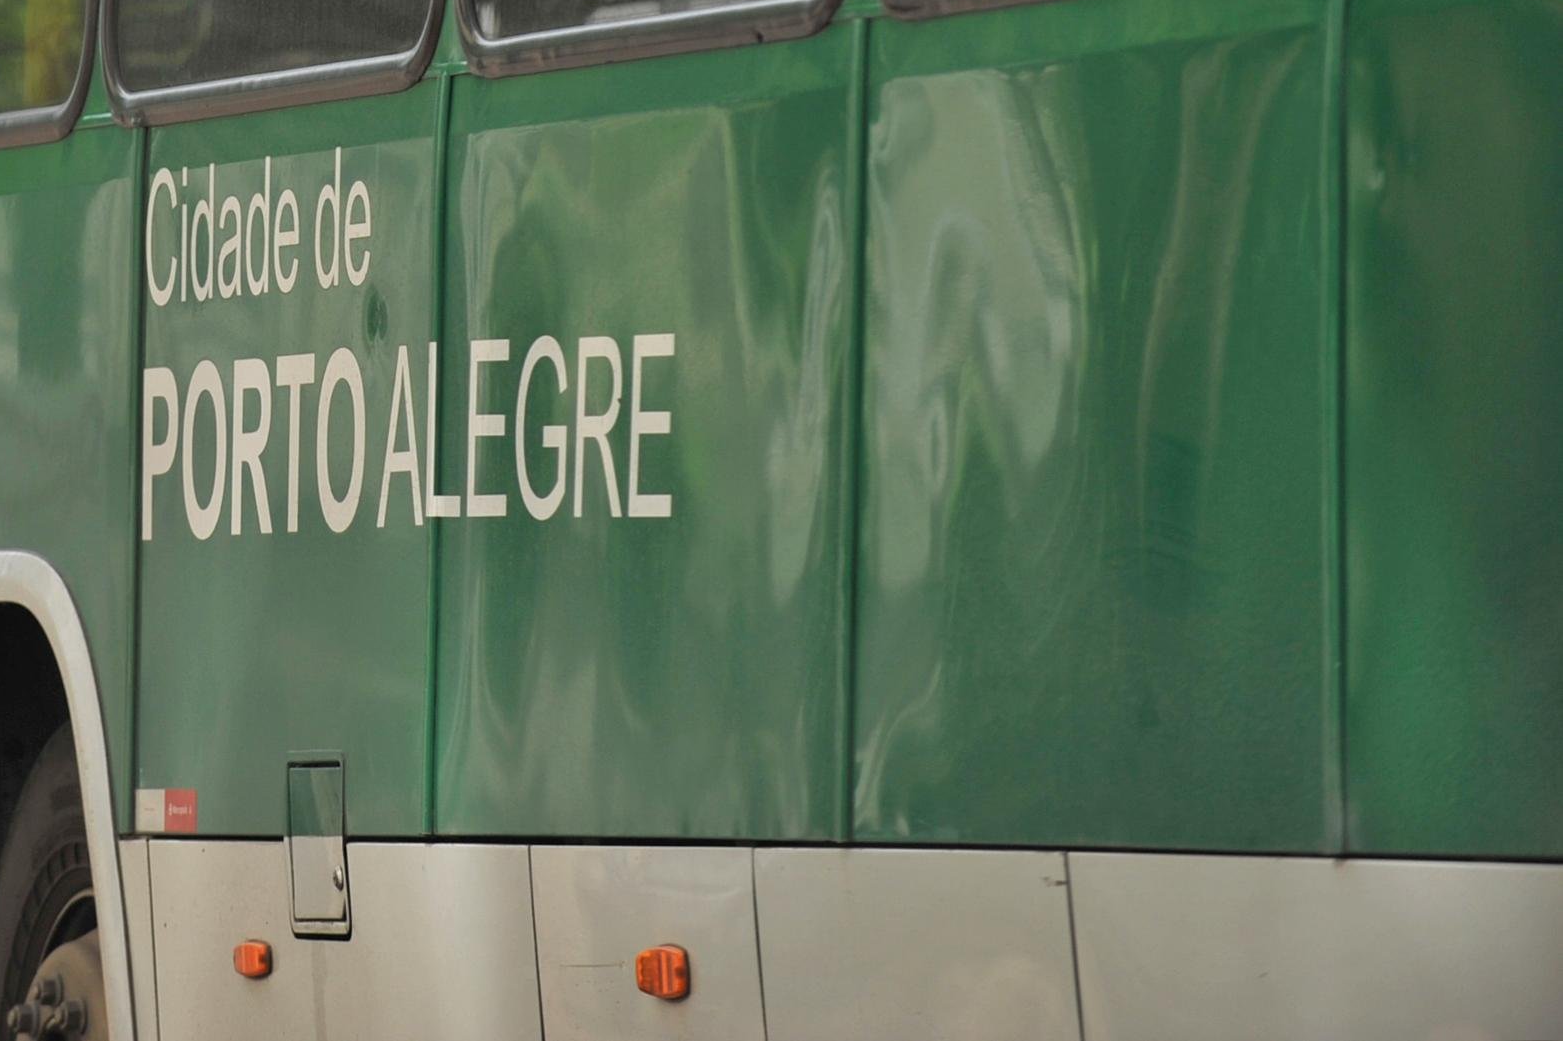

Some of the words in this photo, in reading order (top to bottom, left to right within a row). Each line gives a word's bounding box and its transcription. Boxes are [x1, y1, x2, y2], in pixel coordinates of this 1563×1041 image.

[146, 155, 300, 306] Cidade
[314, 146, 371, 290] de
[141, 347, 366, 541] PORTO
[376, 333, 676, 529] ALEGRE
